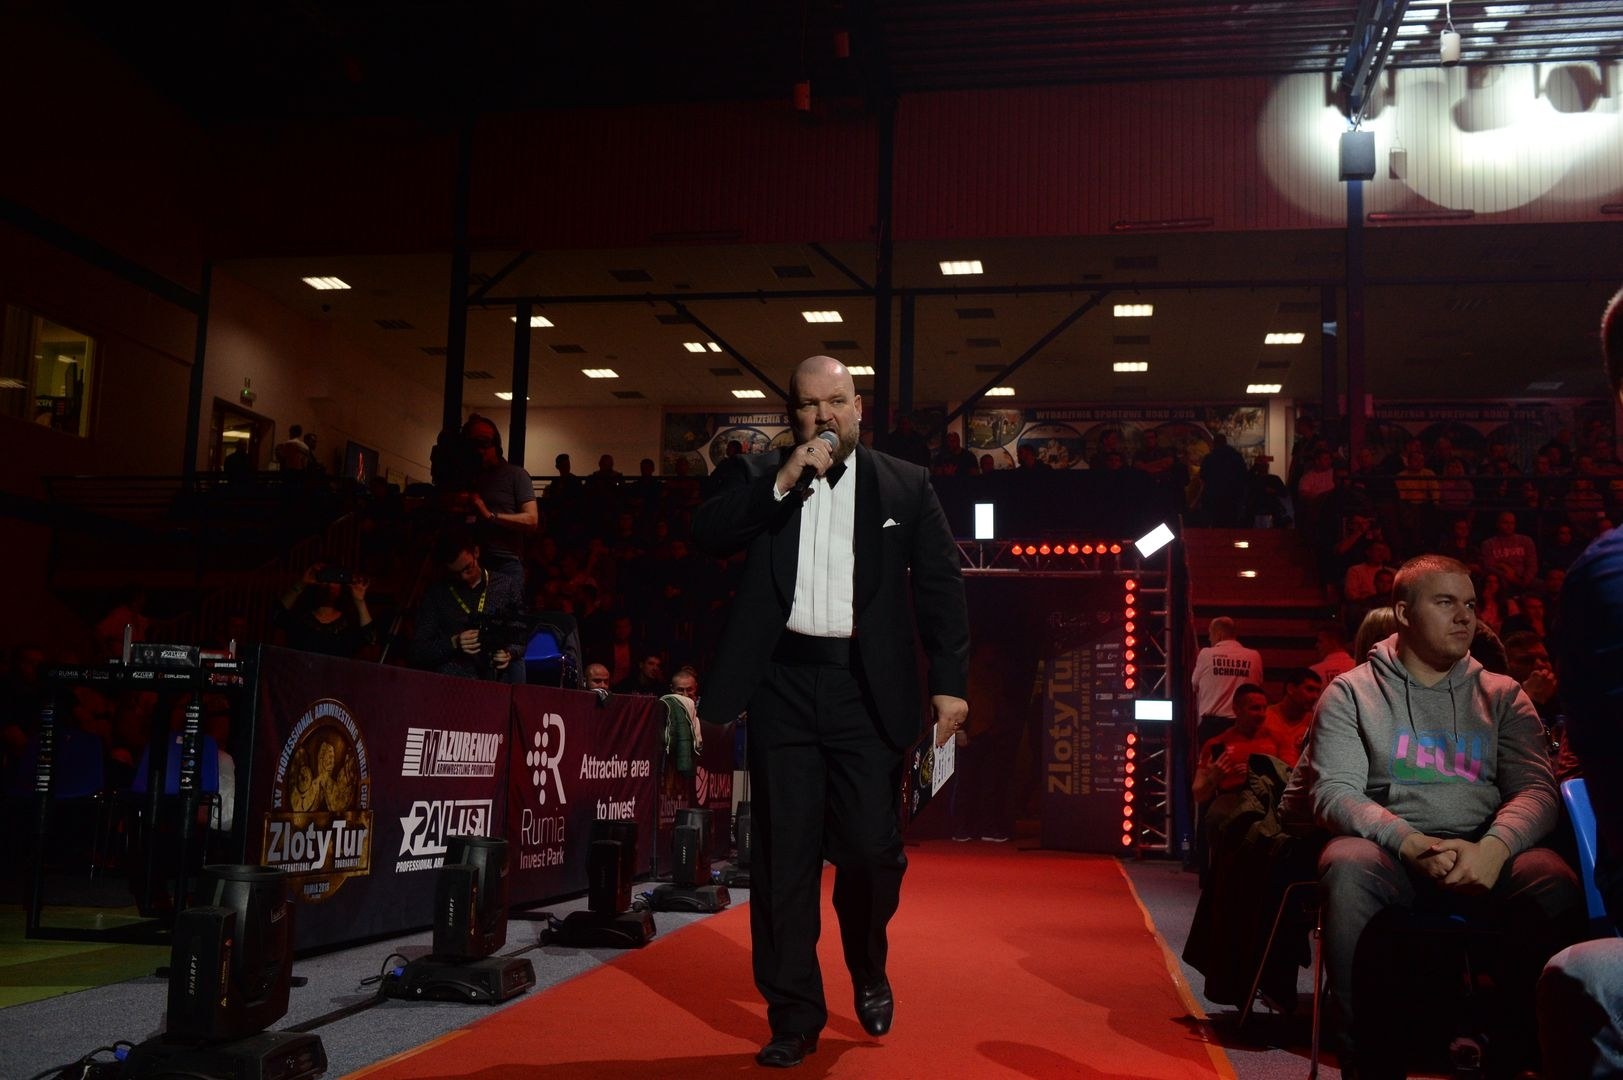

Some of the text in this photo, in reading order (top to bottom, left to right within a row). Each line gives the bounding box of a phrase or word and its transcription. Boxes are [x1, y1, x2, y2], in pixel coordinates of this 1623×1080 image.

[729, 415, 780, 424] WYDARZENIA
[1080, 725, 1091, 749] CUP
[579, 753, 650, 780] Attractive area
[1080, 754, 1091, 795] WORLD
[596, 796, 636, 821] to invest
[520, 807, 566, 847] Rumia
[396, 858, 433, 874] PROFESSIONAL
[520, 845, 565, 871] Invest Park
[188, 954, 198, 997] SHARPY
